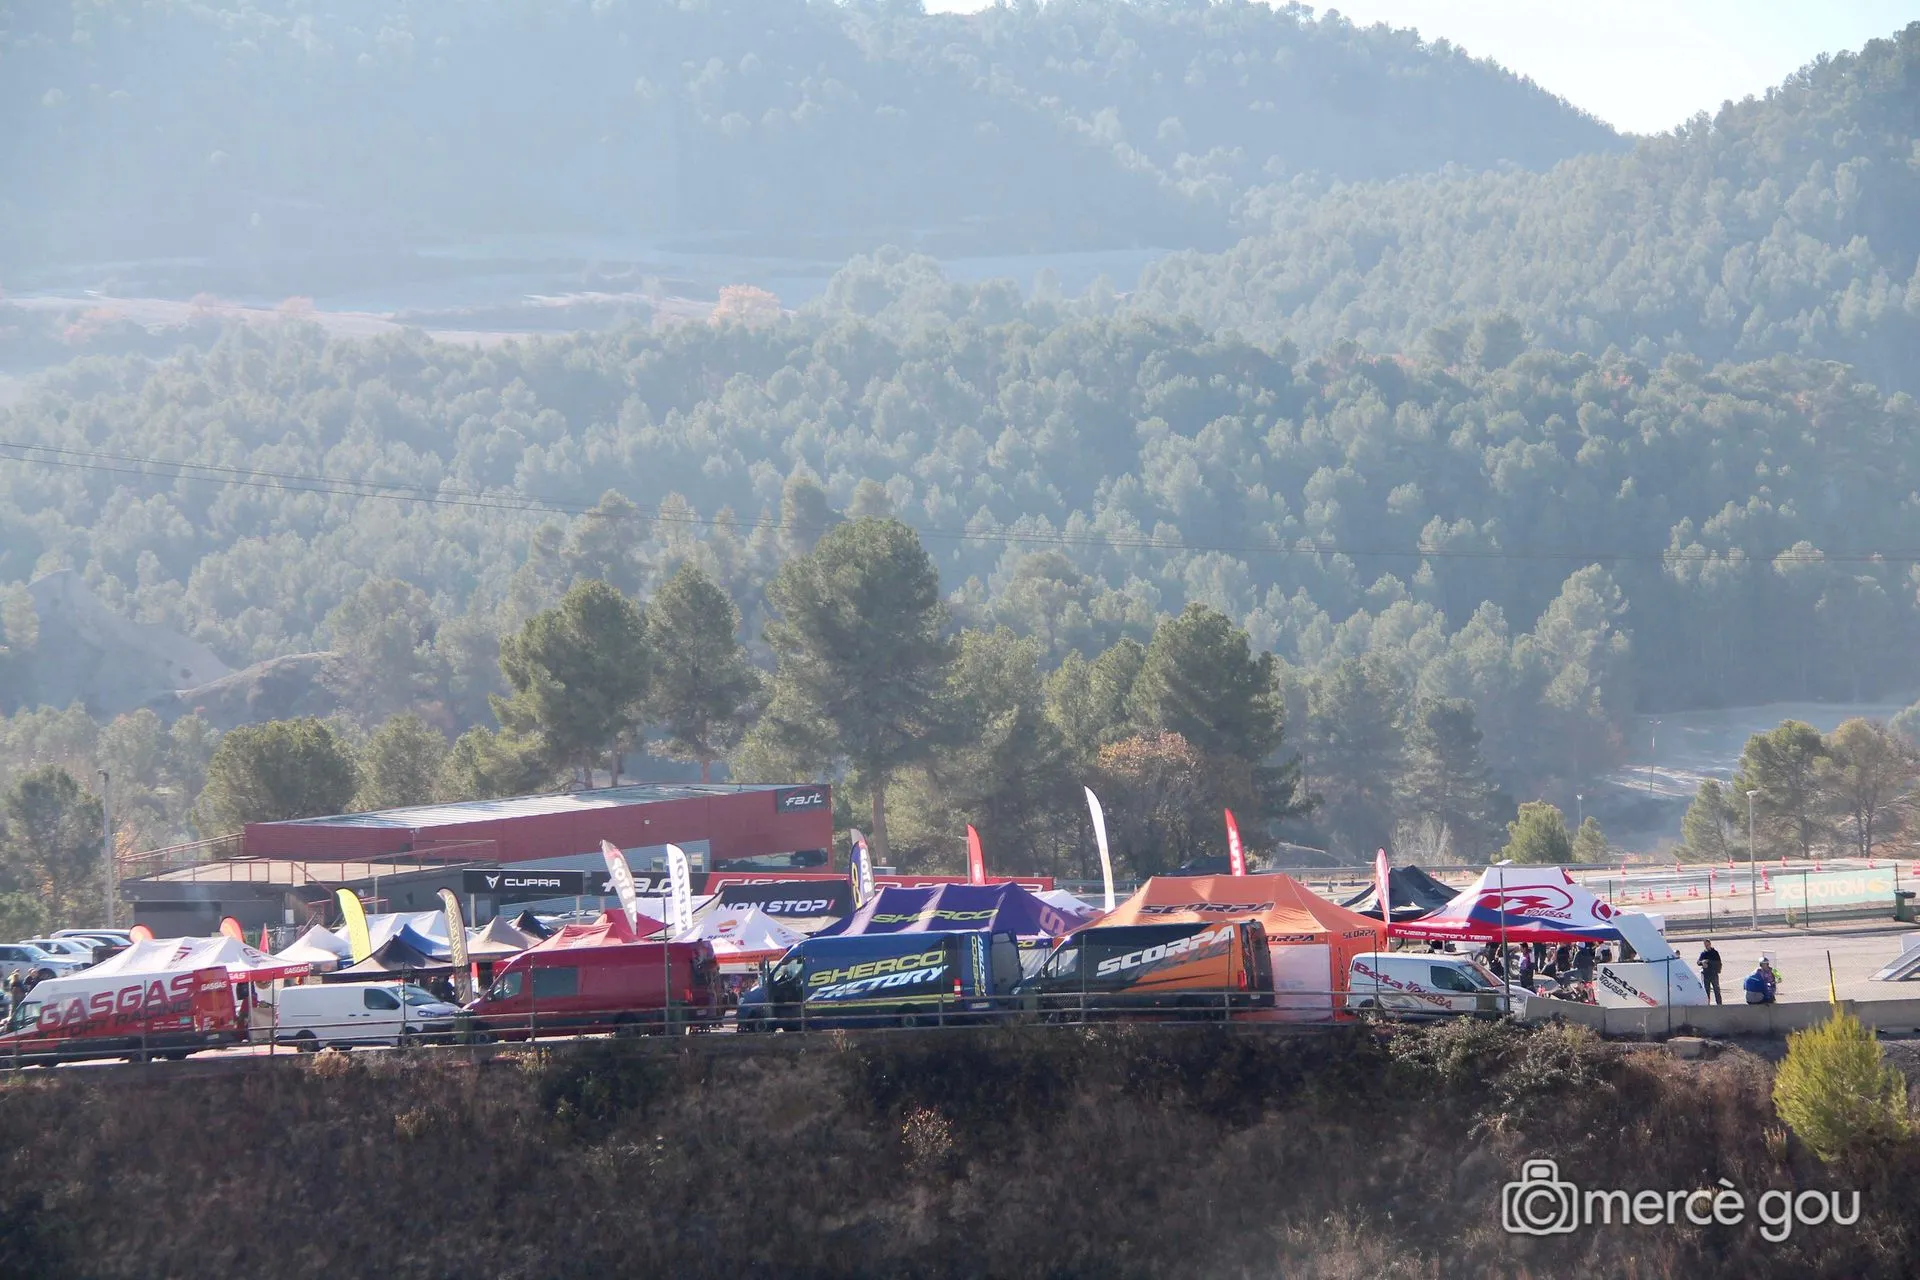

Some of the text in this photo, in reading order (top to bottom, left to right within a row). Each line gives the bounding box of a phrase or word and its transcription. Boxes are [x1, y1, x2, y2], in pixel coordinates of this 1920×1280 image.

[504, 878, 561, 888] CUPRA
[767, 900, 828, 912] STOP
[870, 909, 999, 924] SHERCO
[1139, 902, 1276, 914] SCORPA
[1266, 934, 1315, 942] ORPA
[1096, 925, 1236, 977] SCORPA
[284, 965, 309, 975] GASGAS
[808, 950, 946, 987] SHERCO
[1354, 962, 1404, 990] Beta
[805, 965, 949, 1002] FACTORY
[1602, 966, 1638, 997] Beta
[36, 973, 194, 1031] GASGAS
